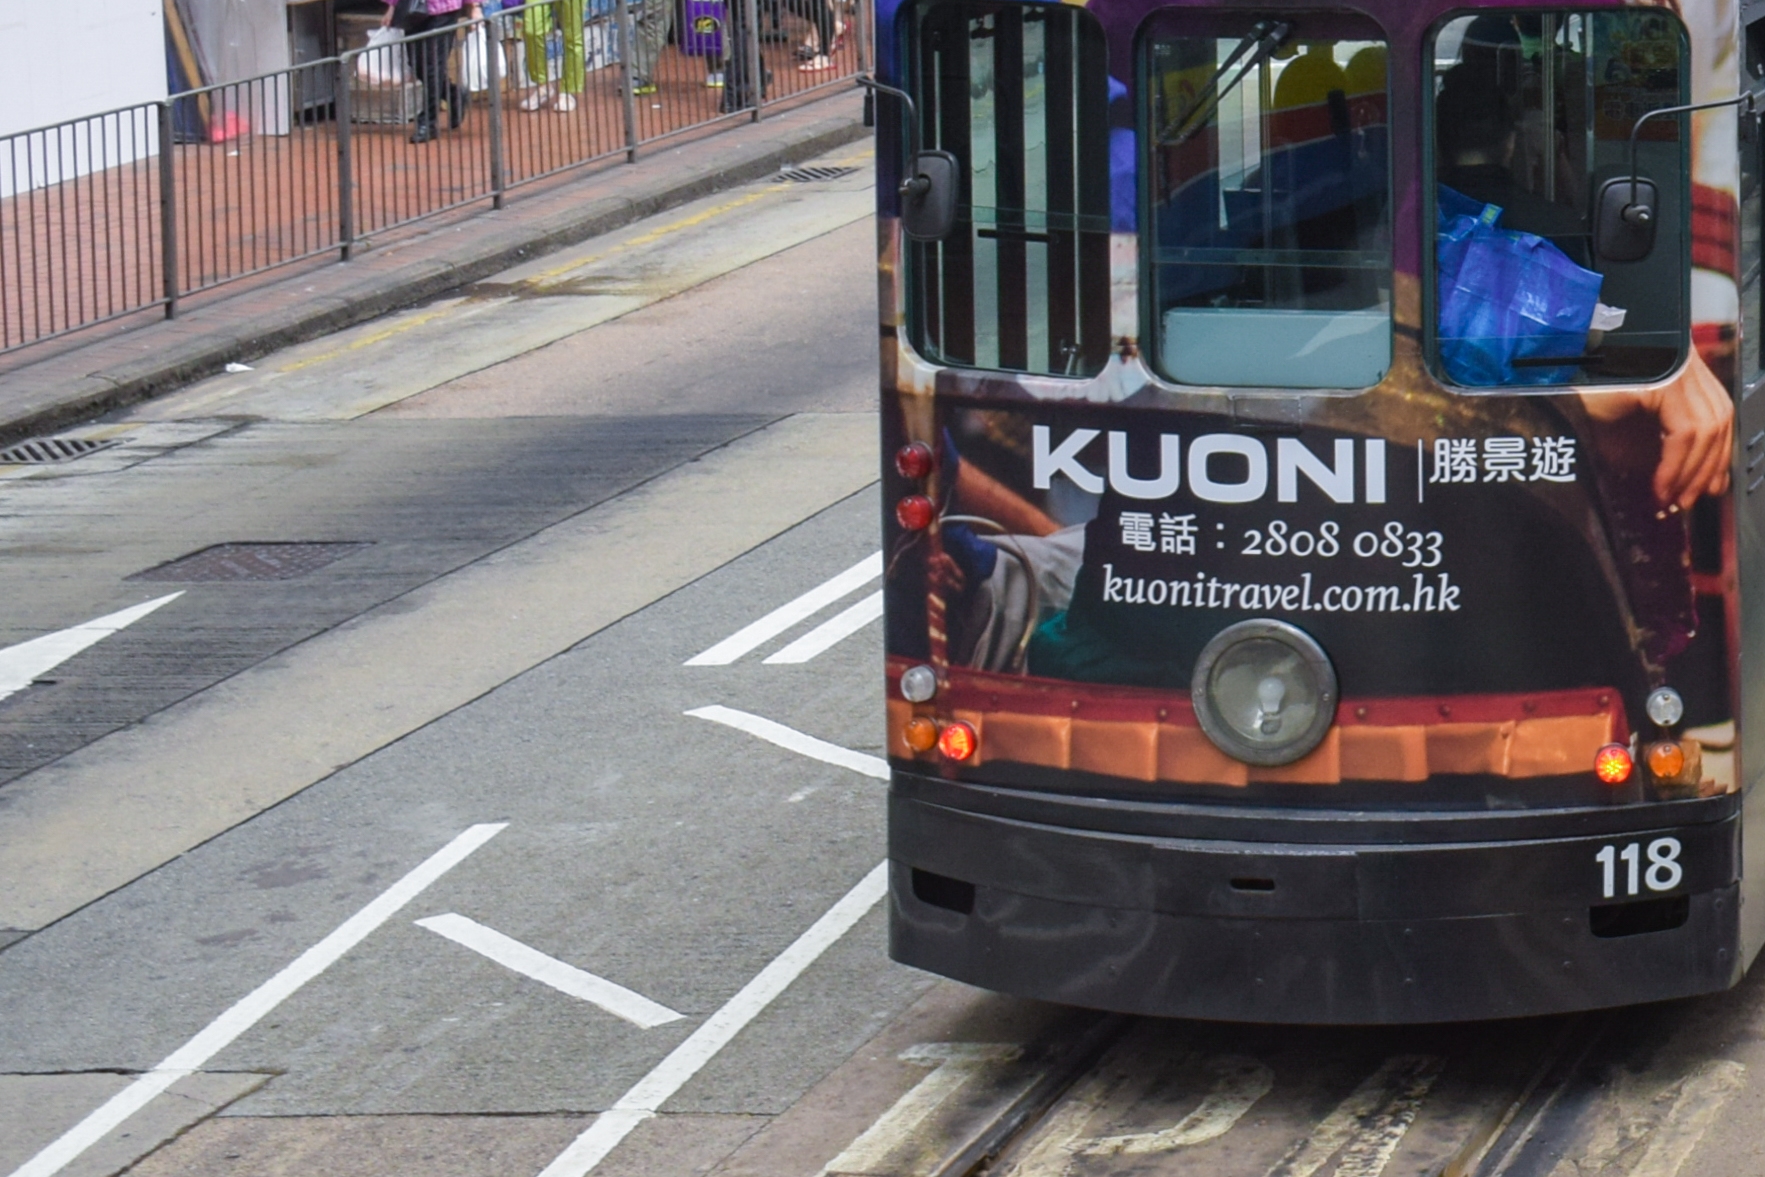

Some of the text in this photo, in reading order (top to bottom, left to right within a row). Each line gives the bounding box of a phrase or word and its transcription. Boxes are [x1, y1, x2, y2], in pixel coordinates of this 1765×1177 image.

[1032, 424, 1386, 503] KUONI
[1429, 436, 1577, 484] 勝景遊
[1240, 520, 1340, 557] 2808
[1352, 521, 1444, 567] 0833
[1102, 563, 1461, 612] kuonitravel.com.hk
[1595, 836, 1683, 899] 118
